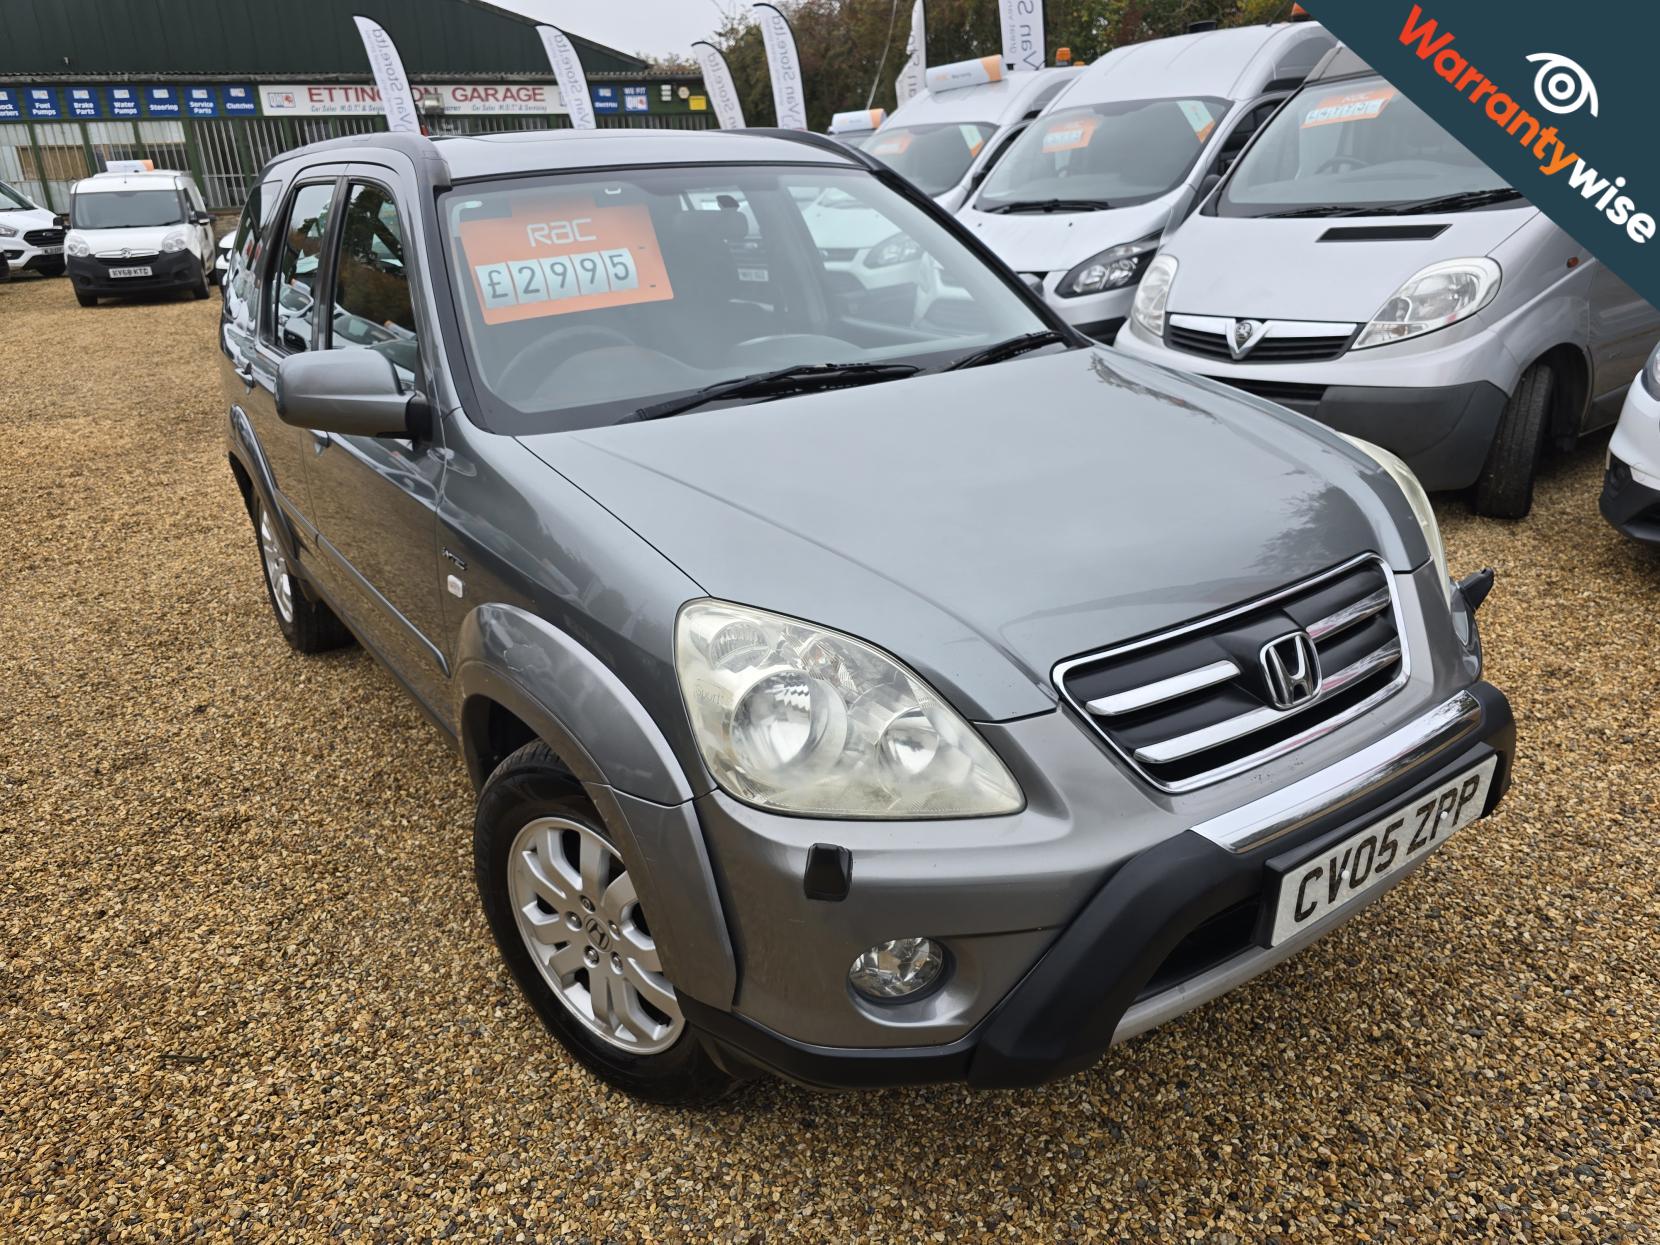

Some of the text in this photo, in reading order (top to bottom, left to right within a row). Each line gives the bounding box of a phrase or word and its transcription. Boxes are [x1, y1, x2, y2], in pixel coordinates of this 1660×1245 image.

[451, 87, 545, 103] GARAGE
[487, 253, 630, 299] £2995
[1294, 774, 1480, 923] CV05 ZPP
